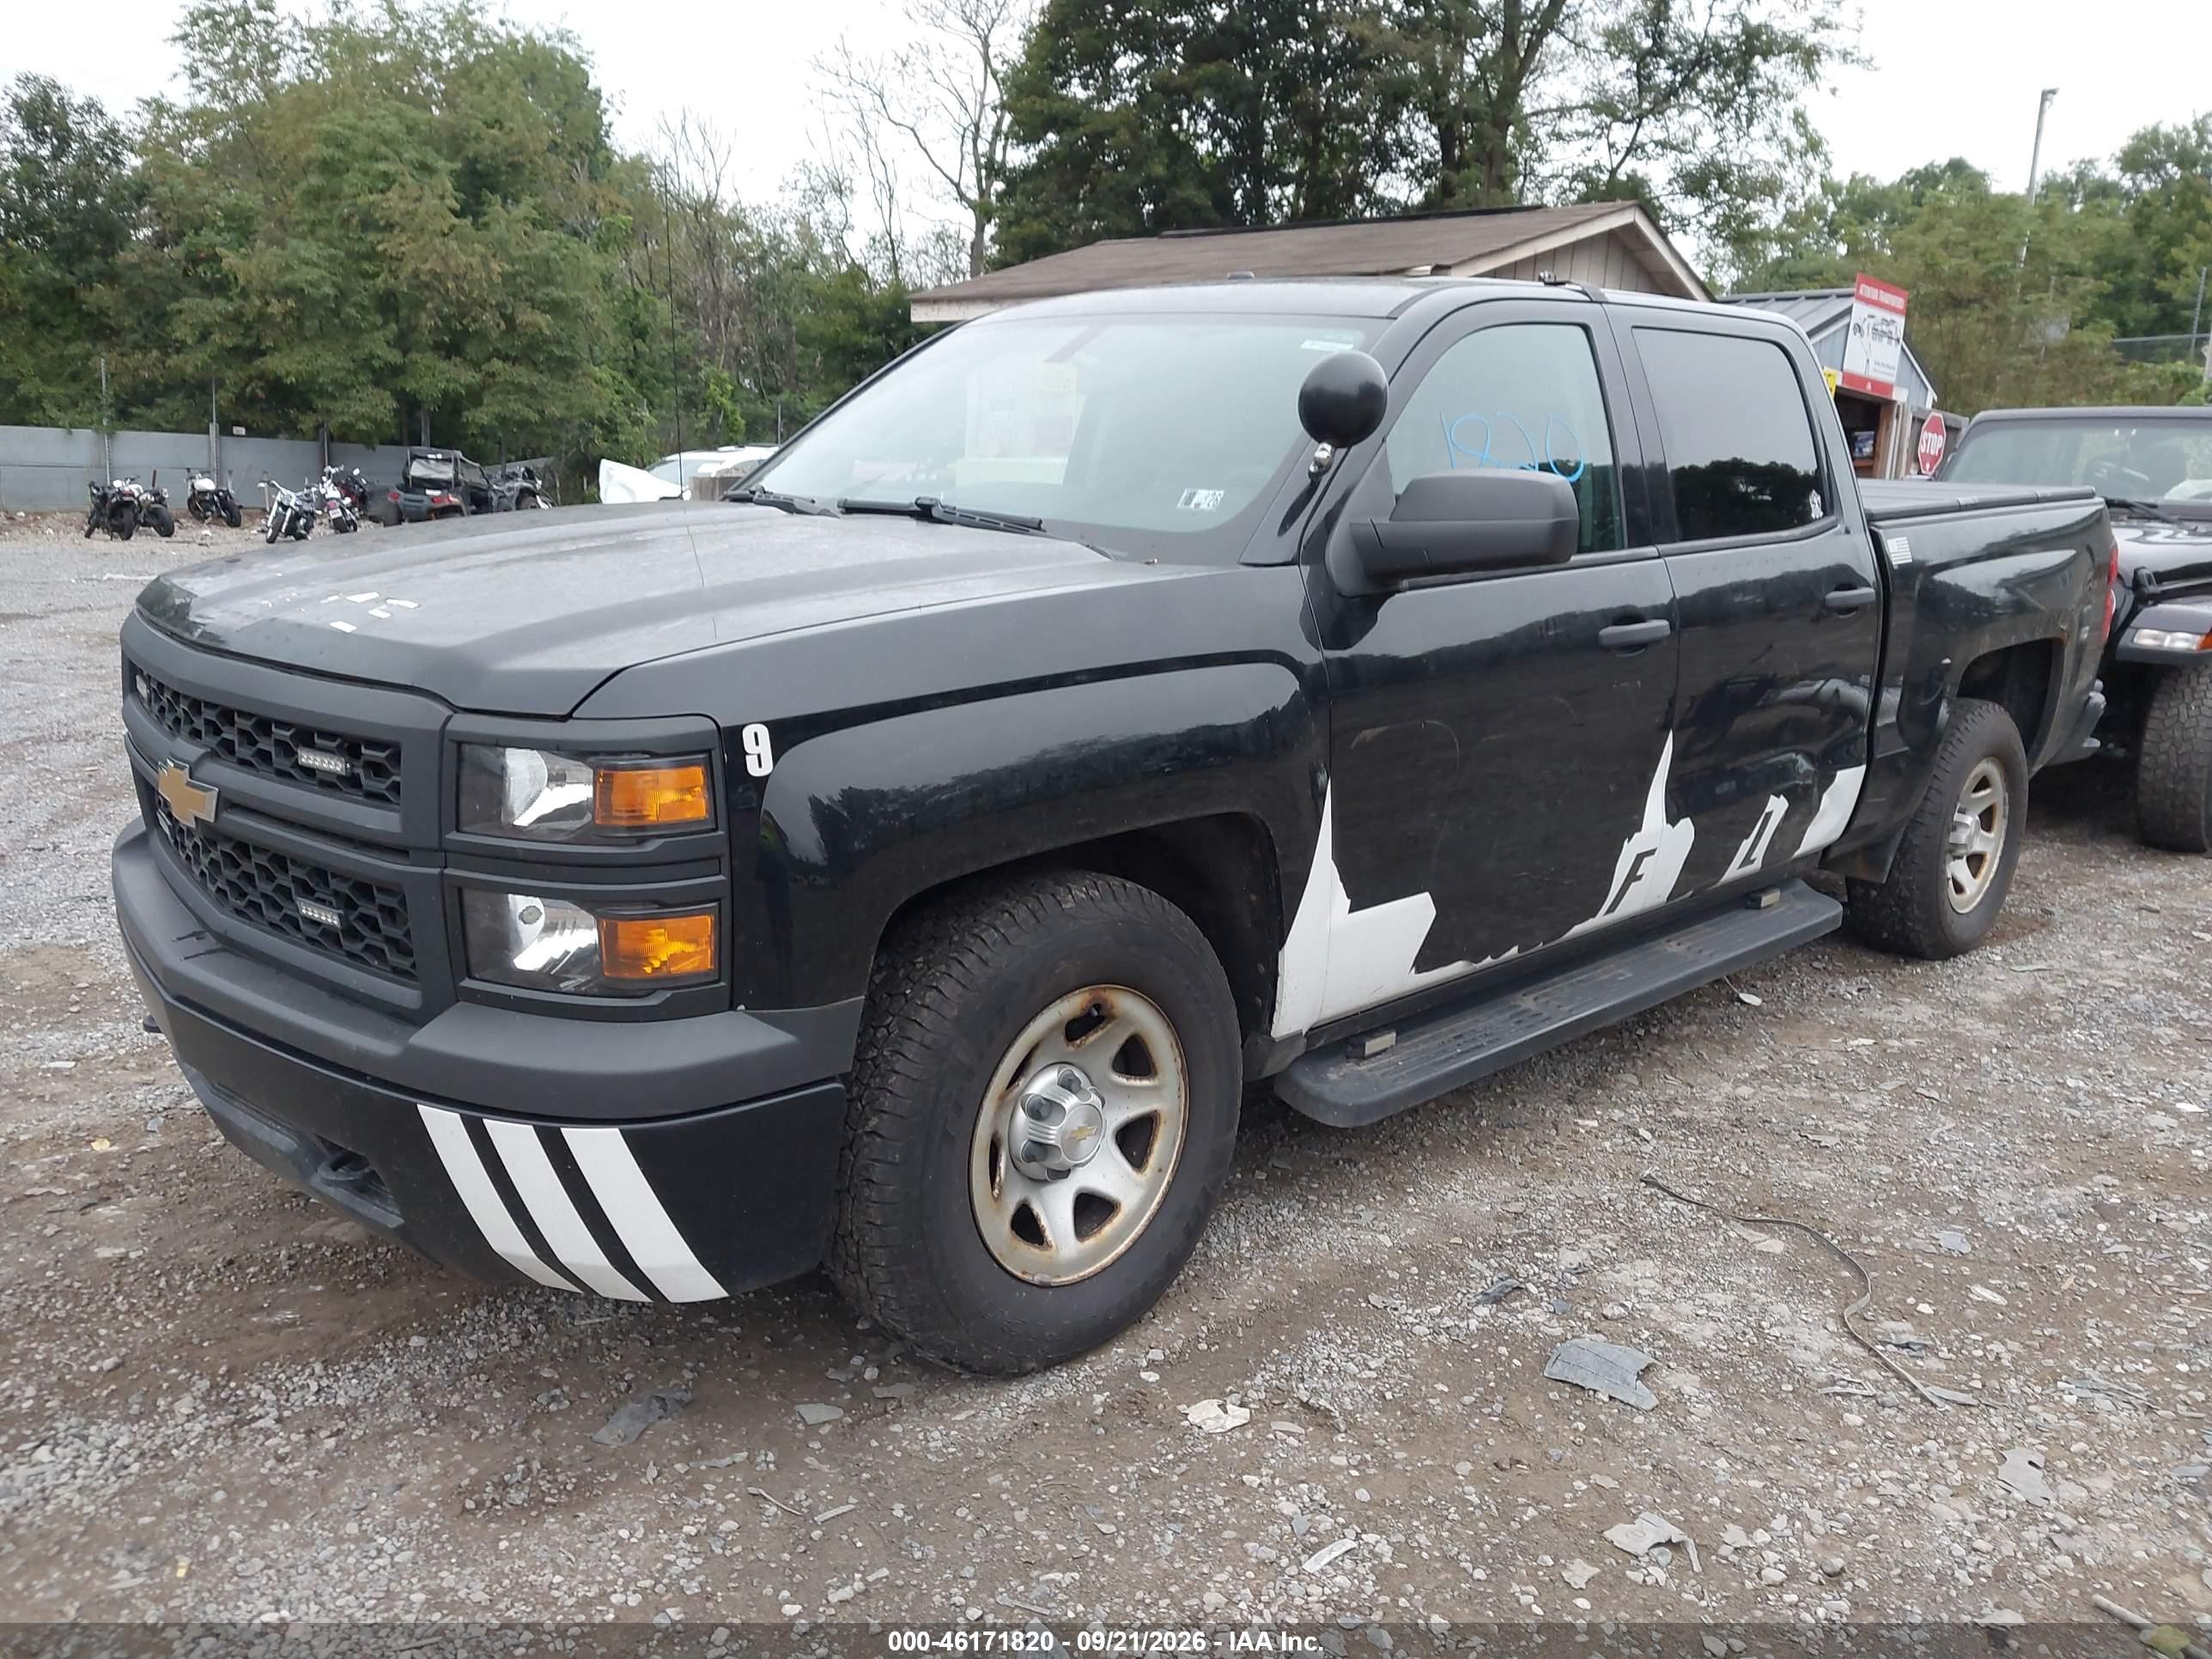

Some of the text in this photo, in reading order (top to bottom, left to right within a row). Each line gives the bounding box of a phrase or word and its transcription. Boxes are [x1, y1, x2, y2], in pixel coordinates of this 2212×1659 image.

[1920, 431, 1944, 456] STOP
[742, 723, 774, 777] 9
[1602, 847, 1659, 917] F
